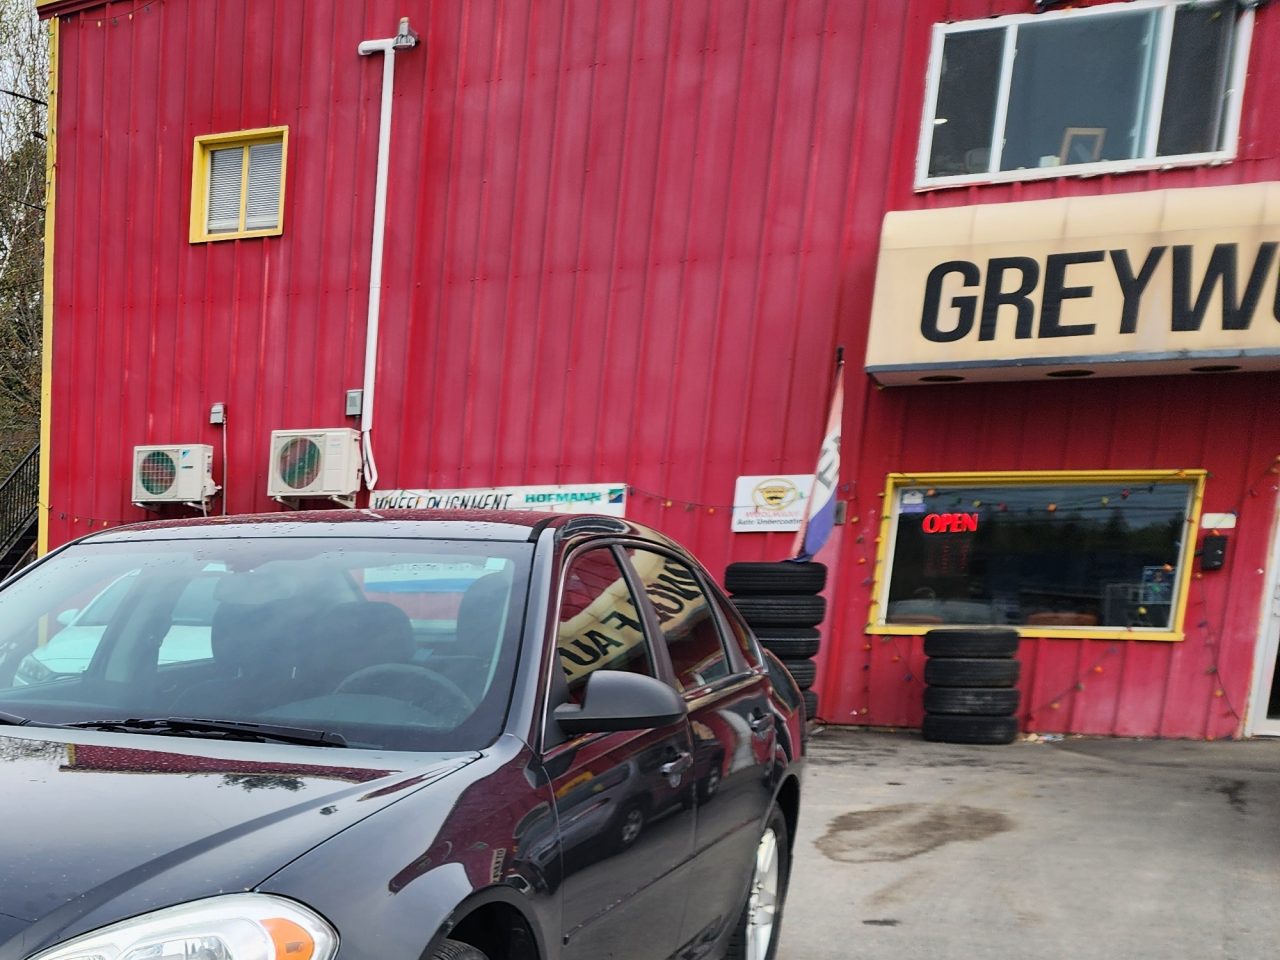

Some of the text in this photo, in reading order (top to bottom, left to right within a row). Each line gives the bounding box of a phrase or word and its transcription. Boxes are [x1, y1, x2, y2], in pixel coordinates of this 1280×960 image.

[920, 241, 1280, 343] GREYW
[524, 492, 601, 504] HOFMANN
[922, 513, 979, 534] OPEN
